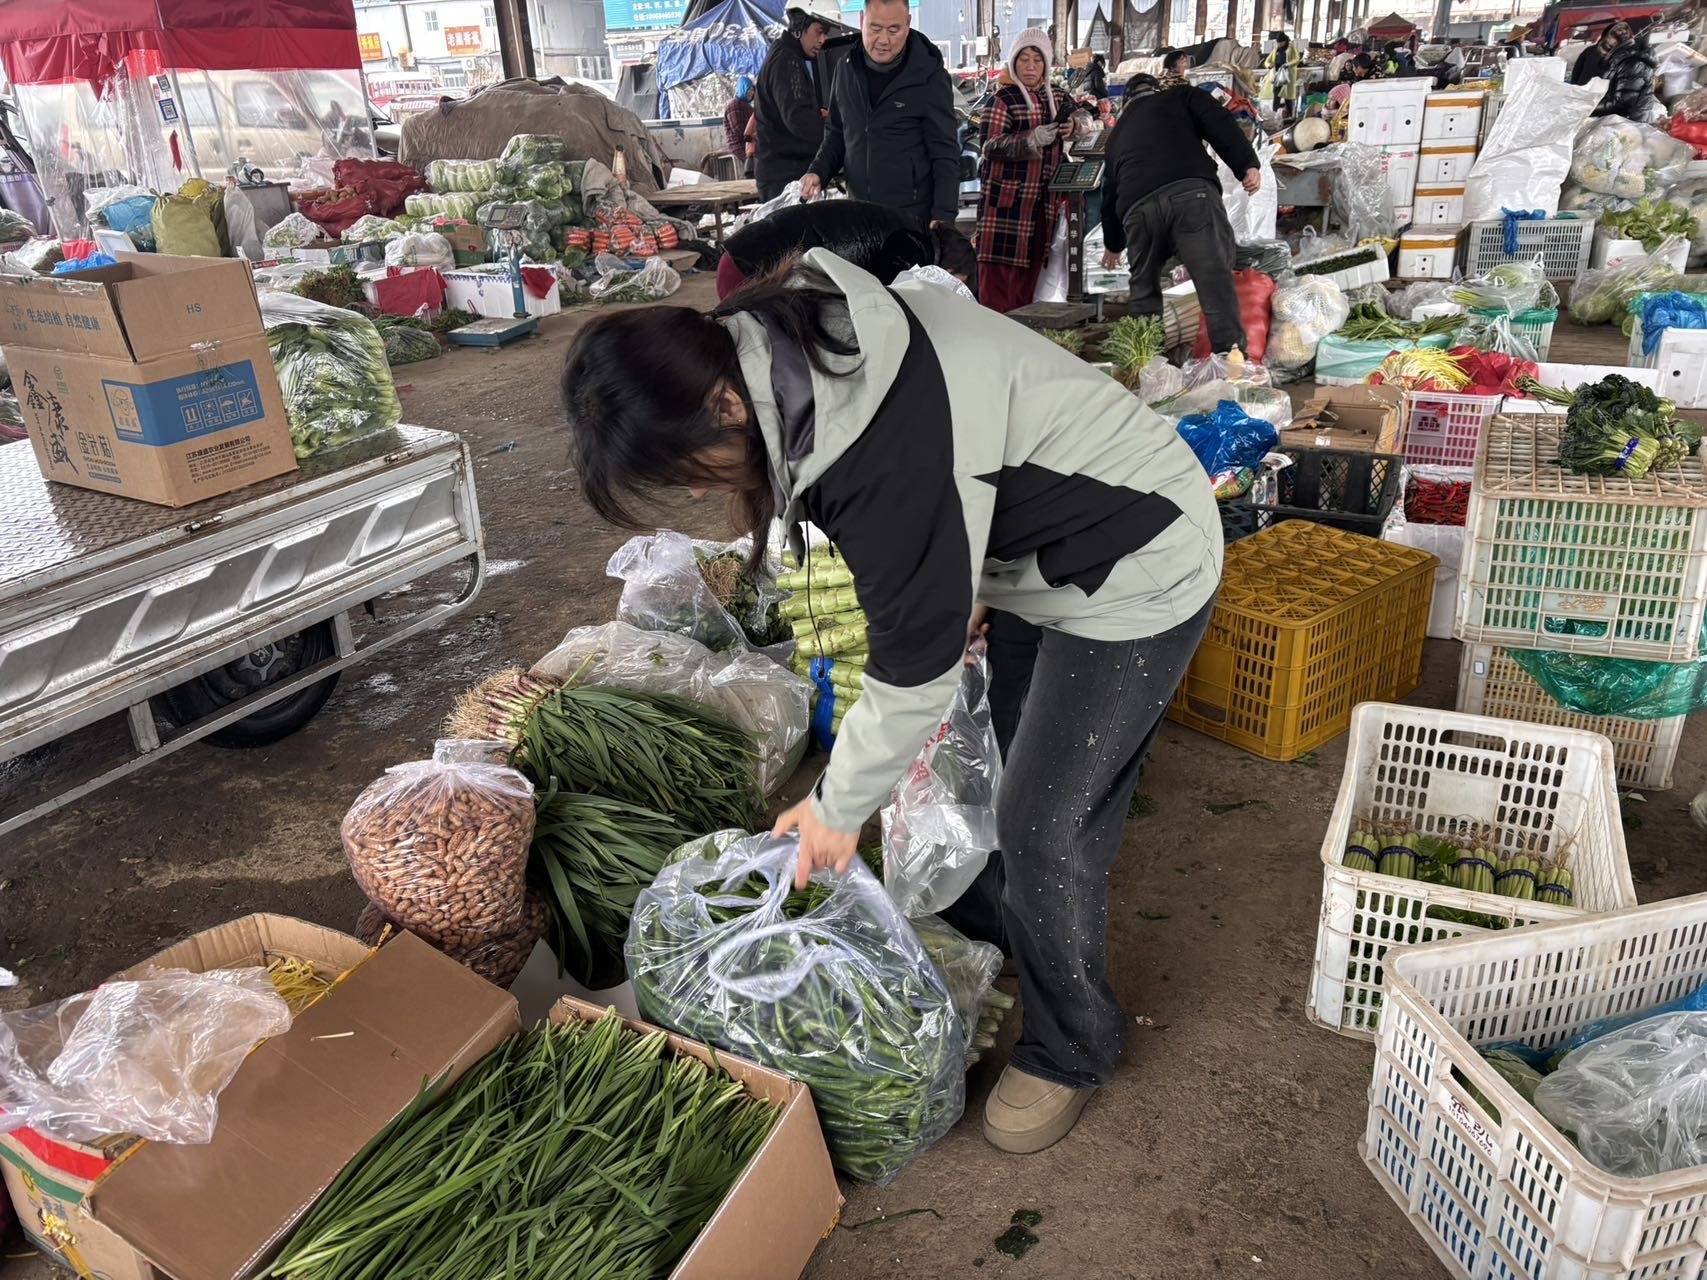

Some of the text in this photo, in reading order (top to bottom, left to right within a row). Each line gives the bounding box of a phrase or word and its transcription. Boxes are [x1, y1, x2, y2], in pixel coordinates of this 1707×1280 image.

[186, 303, 202, 314] HS
[78, 431, 113, 459] 金针菇
